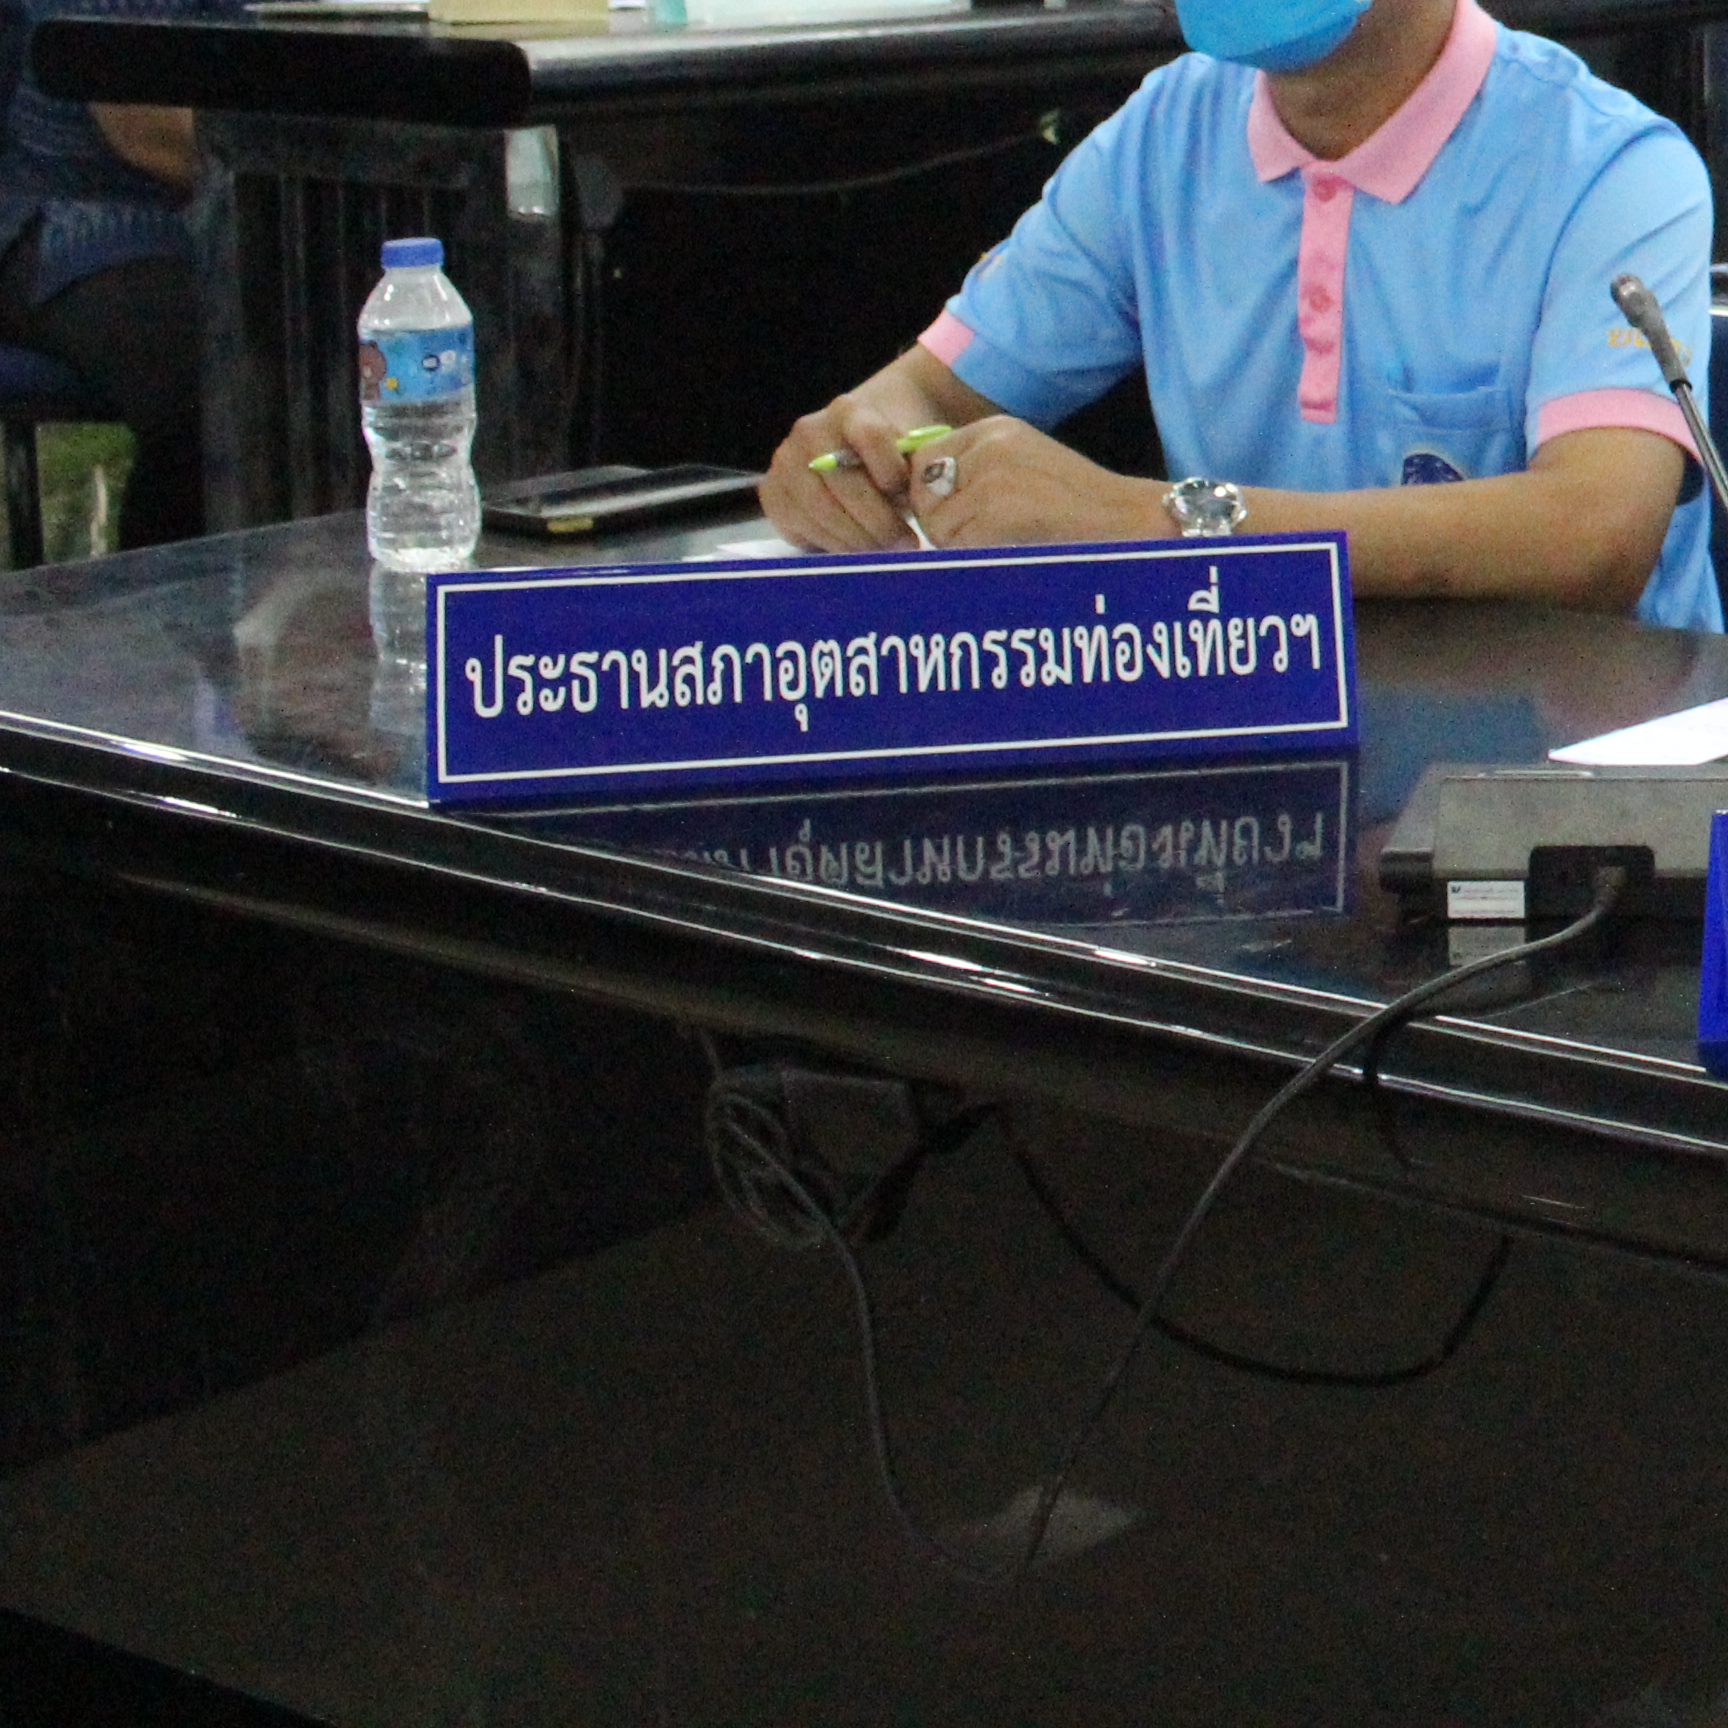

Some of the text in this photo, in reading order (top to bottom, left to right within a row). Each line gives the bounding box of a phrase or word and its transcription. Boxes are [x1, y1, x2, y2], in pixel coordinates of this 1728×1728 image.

[465, 566, 1321, 732] ประธานสภาอุตสาหกรรมท่องเที่ยวฯ
